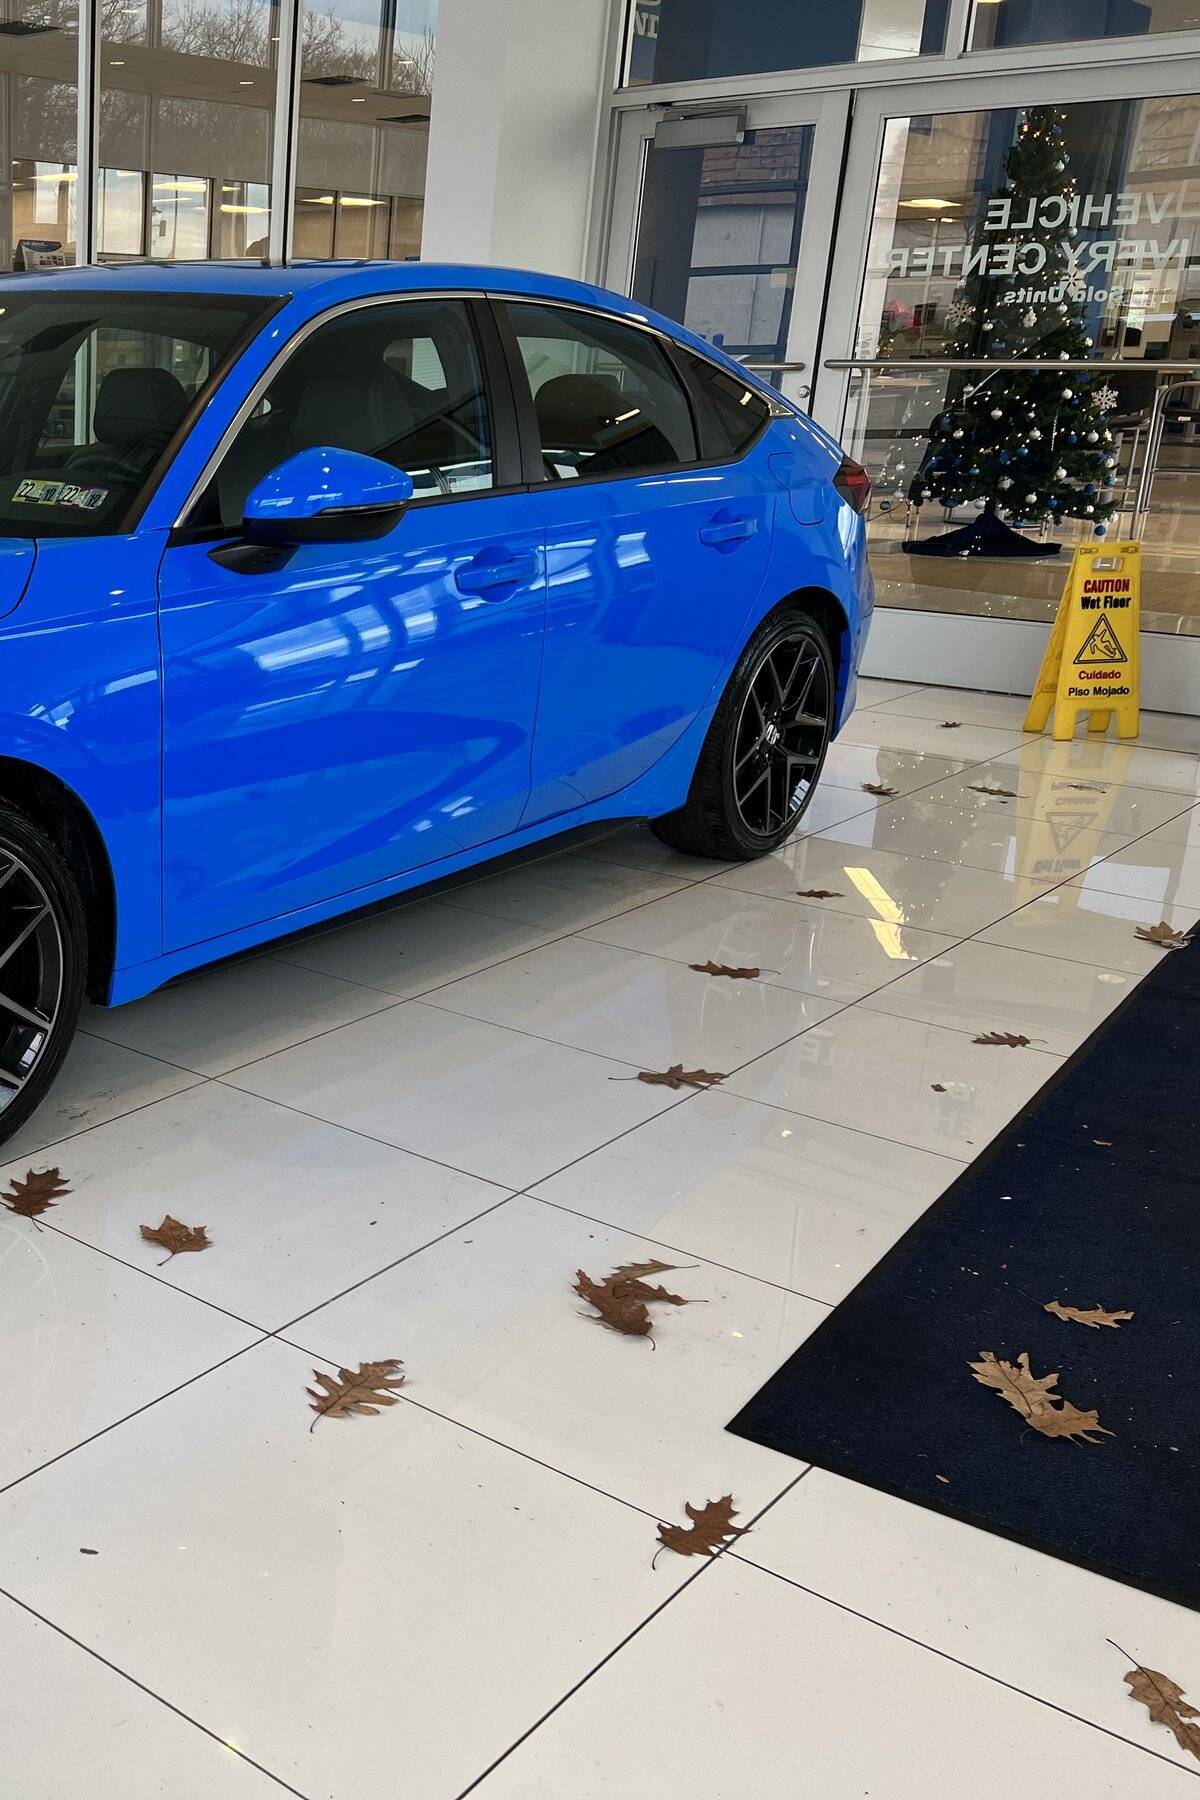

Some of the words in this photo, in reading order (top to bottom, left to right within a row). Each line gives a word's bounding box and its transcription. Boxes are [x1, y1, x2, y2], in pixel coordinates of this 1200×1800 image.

[17, 482, 36, 498] 22
[61, 487, 80, 503] 22
[1083, 579, 1130, 593] CAUTION
[1081, 596, 1101, 609] Wet
[1103, 595, 1131, 609] Floor
[1078, 669, 1122, 680] Cuidado
[1068, 687, 1090, 697] Piso
[1093, 686, 1130, 697] Mojado
